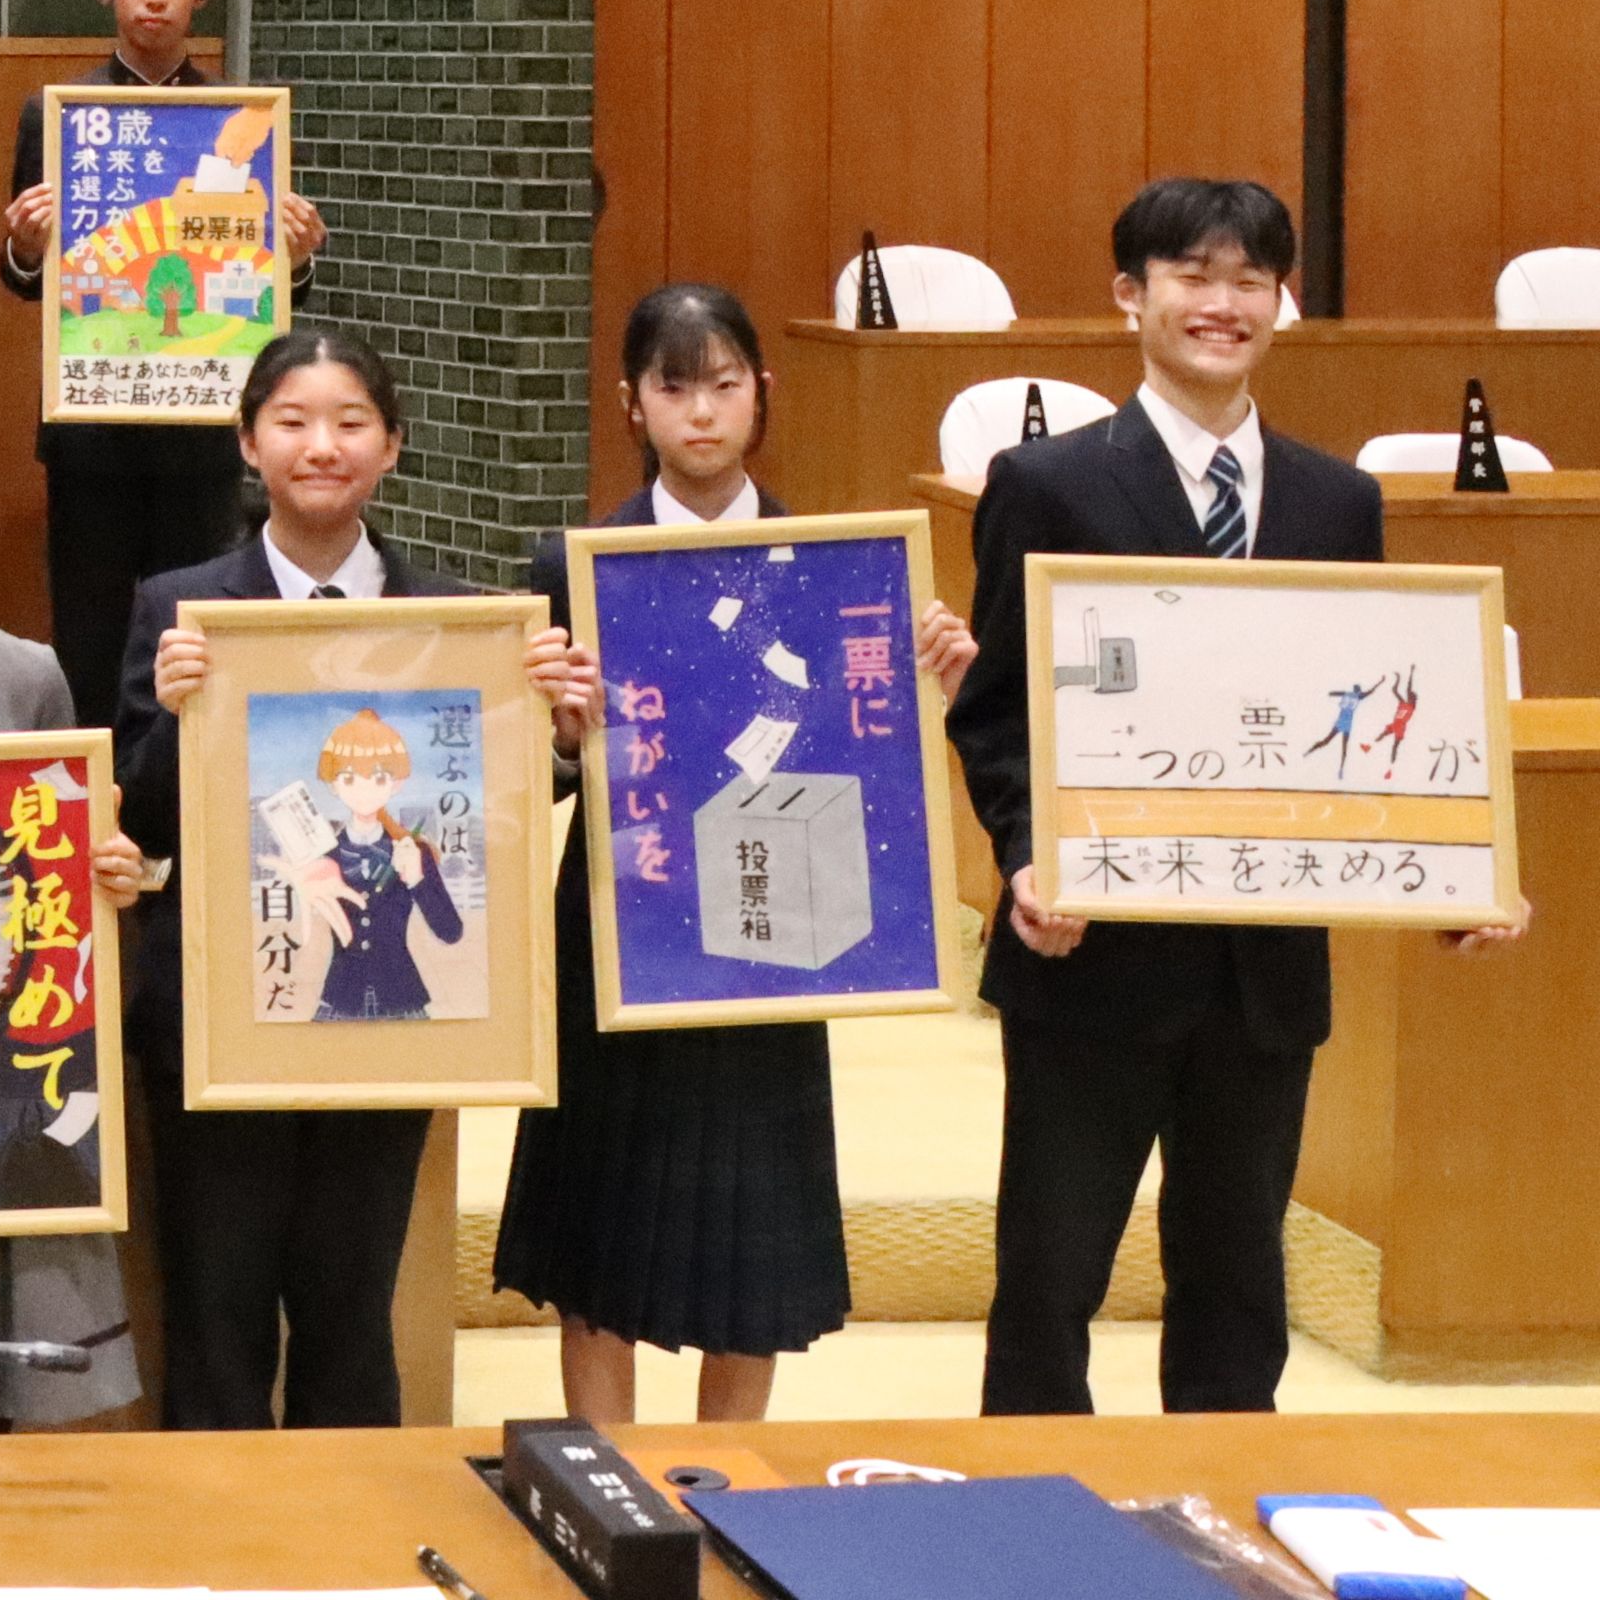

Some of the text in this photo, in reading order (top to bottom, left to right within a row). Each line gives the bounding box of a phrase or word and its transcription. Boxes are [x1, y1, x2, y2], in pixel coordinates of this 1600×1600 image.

[180, 215, 257, 242] 投票箱
[62, 358, 233, 382] 選挙はあなたの声を
[64, 382, 241, 407] 社会に届ける方法で
[839, 602, 896, 738] 一票に
[427, 703, 478, 872] 選ぶのは、
[620, 678, 672, 884] ねがいを
[0, 782, 79, 1110] 見極めて
[256, 879, 303, 1013] 自分だ
[735, 839, 772, 942] 投票箱
